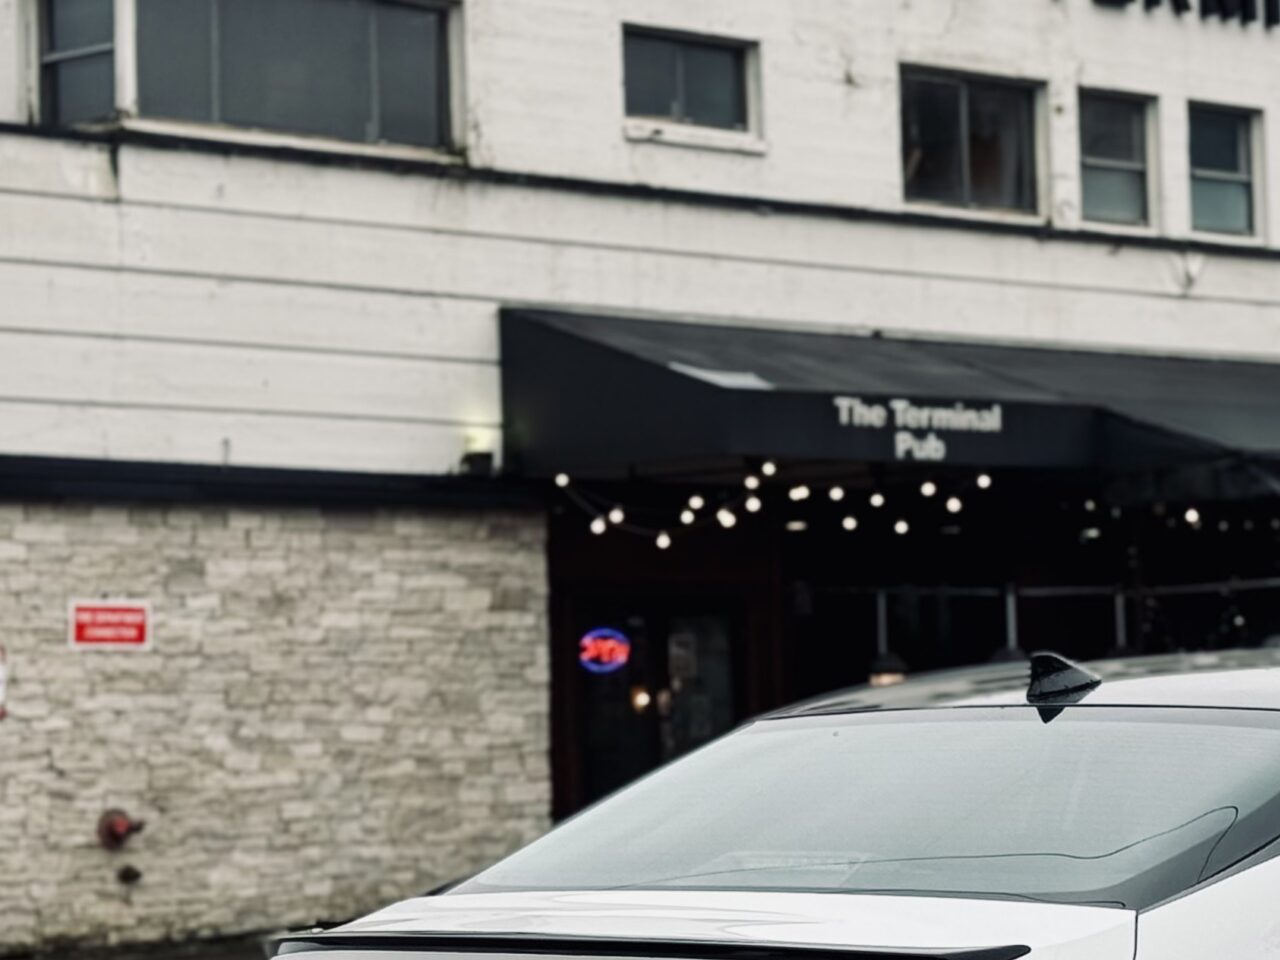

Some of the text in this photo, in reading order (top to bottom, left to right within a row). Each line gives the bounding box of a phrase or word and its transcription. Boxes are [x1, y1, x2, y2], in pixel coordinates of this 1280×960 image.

[833, 396, 1003, 432] The Terminal
[894, 431, 946, 460] Pub
